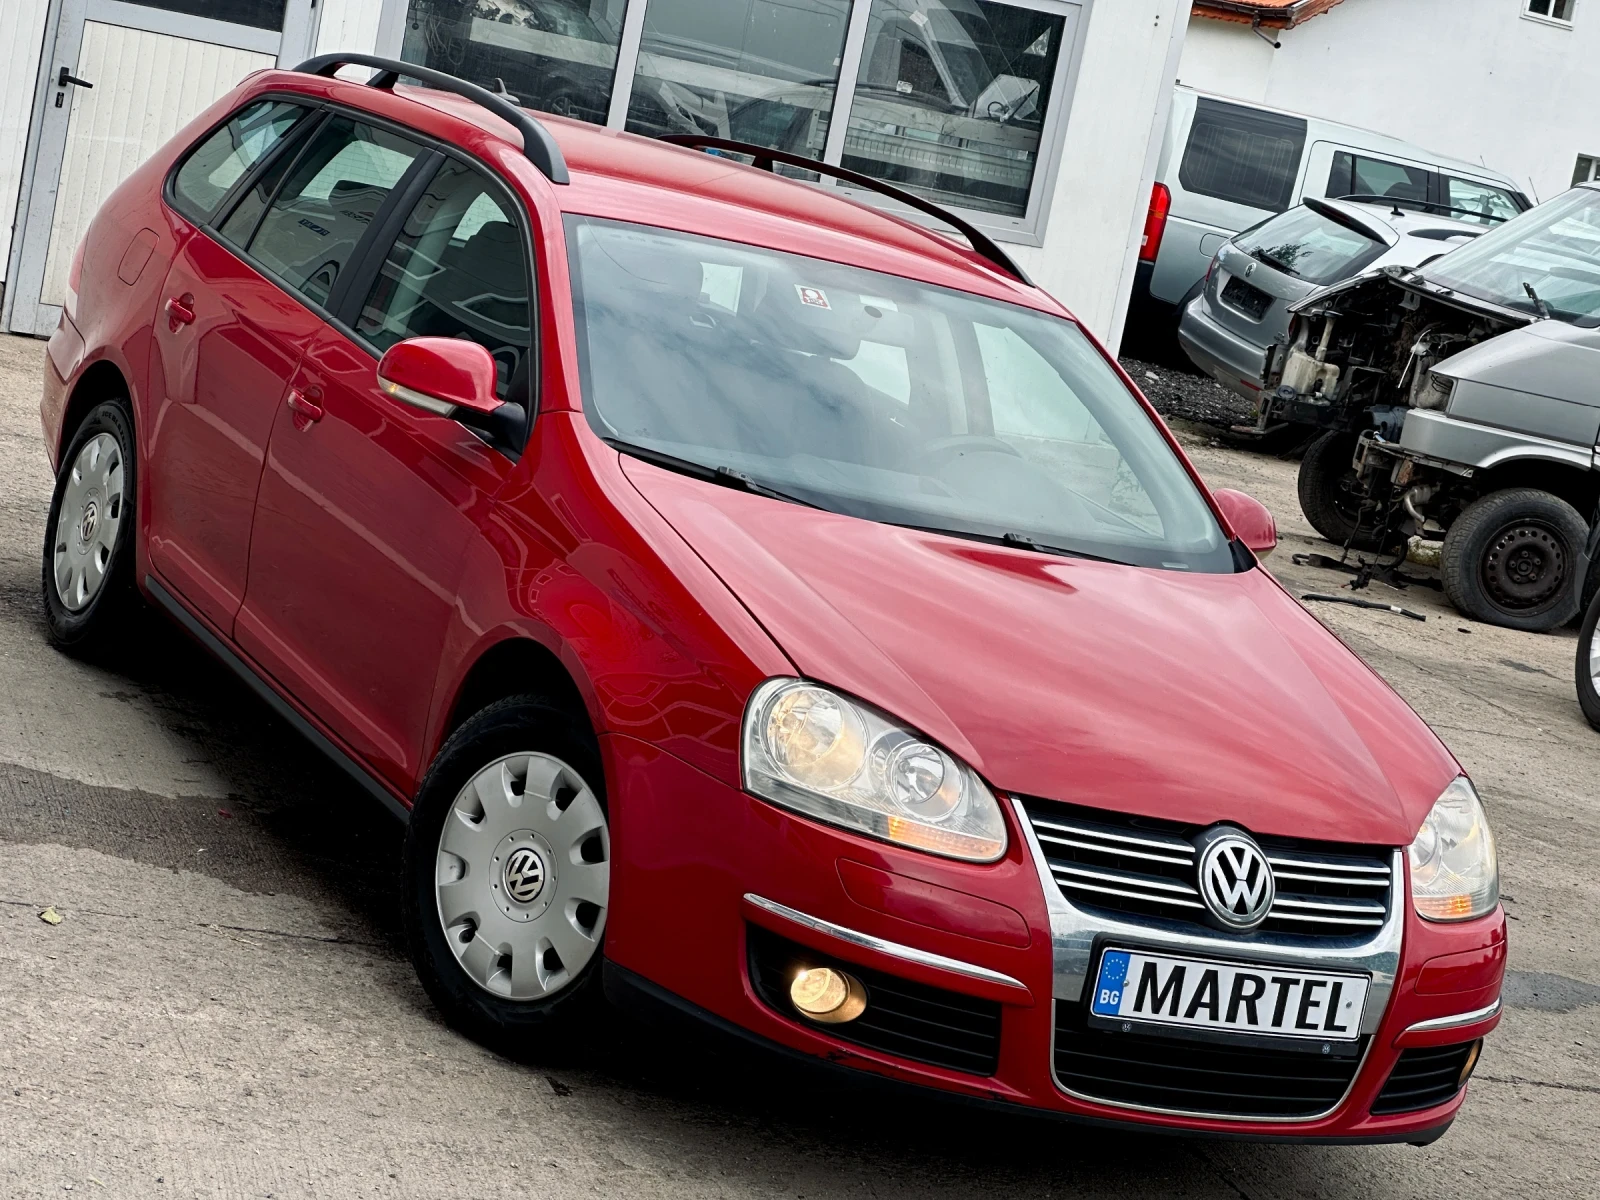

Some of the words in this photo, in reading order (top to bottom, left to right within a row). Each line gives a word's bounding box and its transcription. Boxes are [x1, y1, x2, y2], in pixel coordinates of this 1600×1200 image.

[506, 849, 544, 901] VW
[1205, 840, 1271, 922] VW
[1100, 989, 1119, 1005] BG
[1132, 961, 1348, 1033] MARTEL
